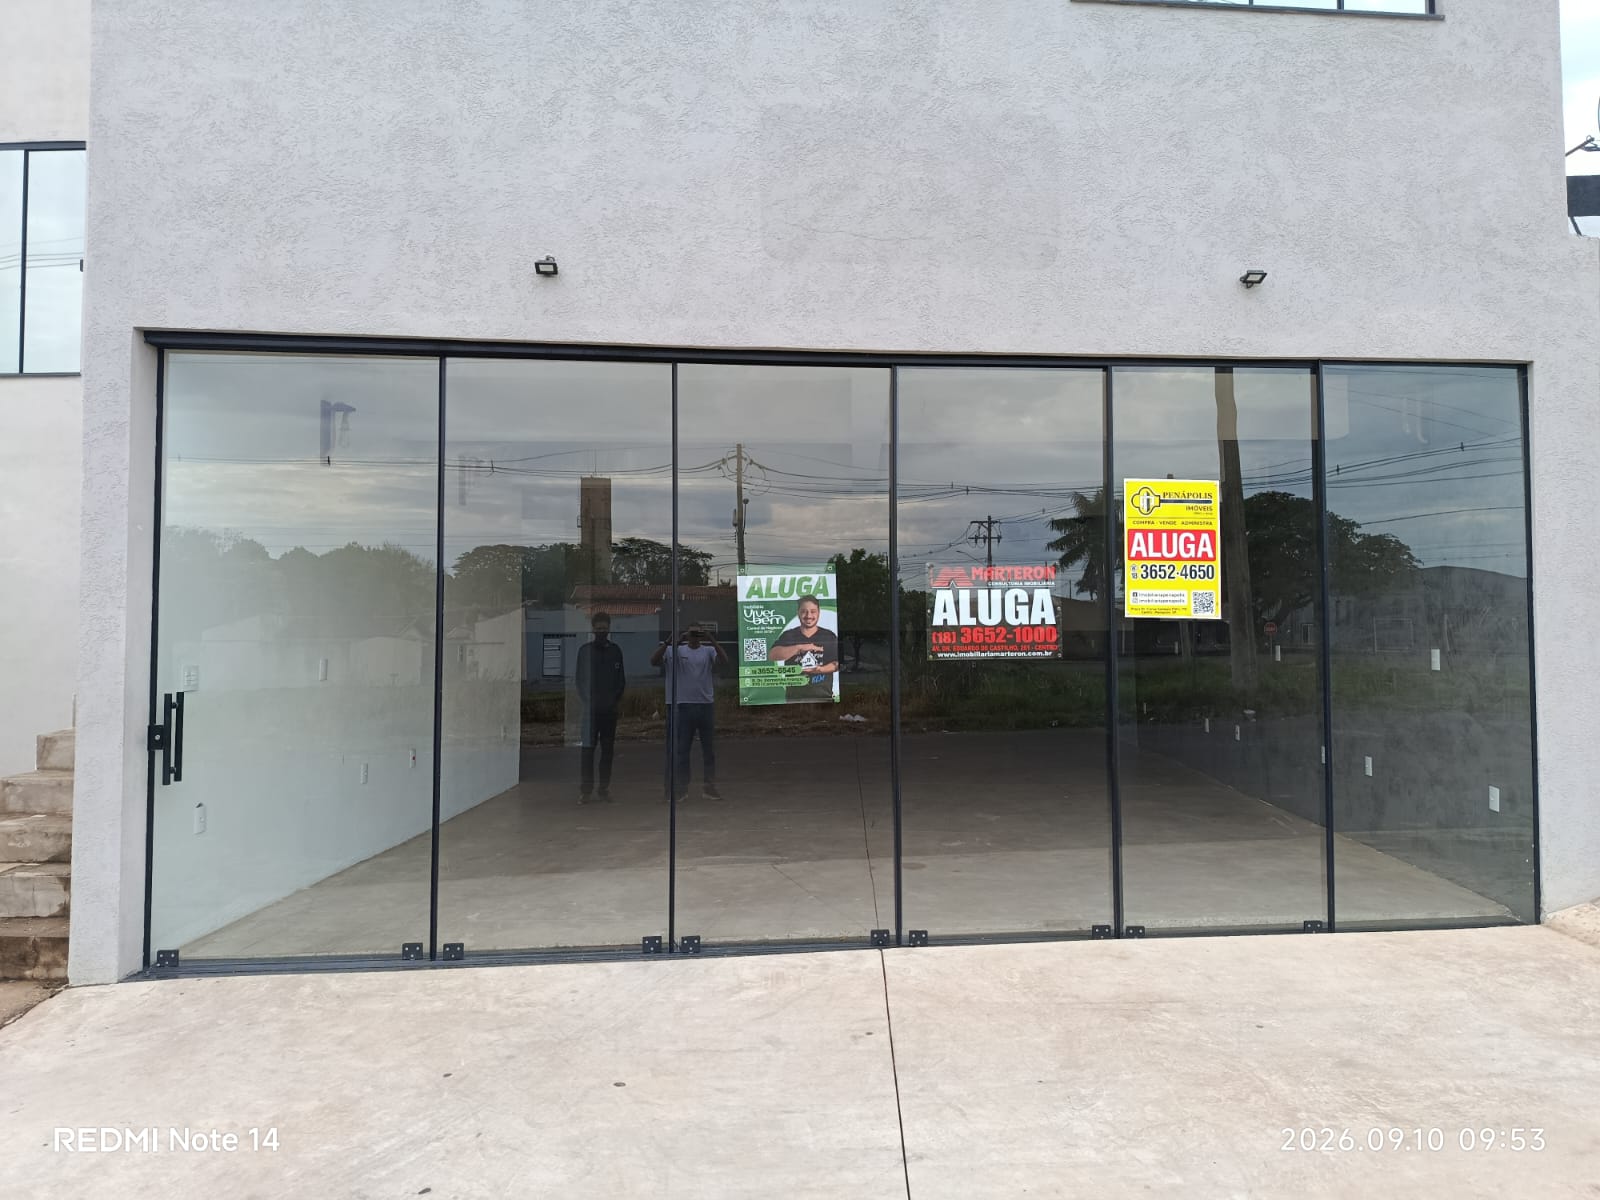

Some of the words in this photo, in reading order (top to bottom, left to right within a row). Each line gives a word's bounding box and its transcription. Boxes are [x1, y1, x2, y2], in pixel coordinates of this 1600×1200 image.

[1163, 491, 1213, 499] PENÁPOLIS
[1130, 532, 1214, 558] ALUGA
[971, 566, 1056, 581] MARTERON
[746, 576, 829, 598] ALUGA
[932, 589, 1057, 626] ALUGA
[931, 631, 957, 644] (18)
[960, 626, 1058, 644] 3652-1000
